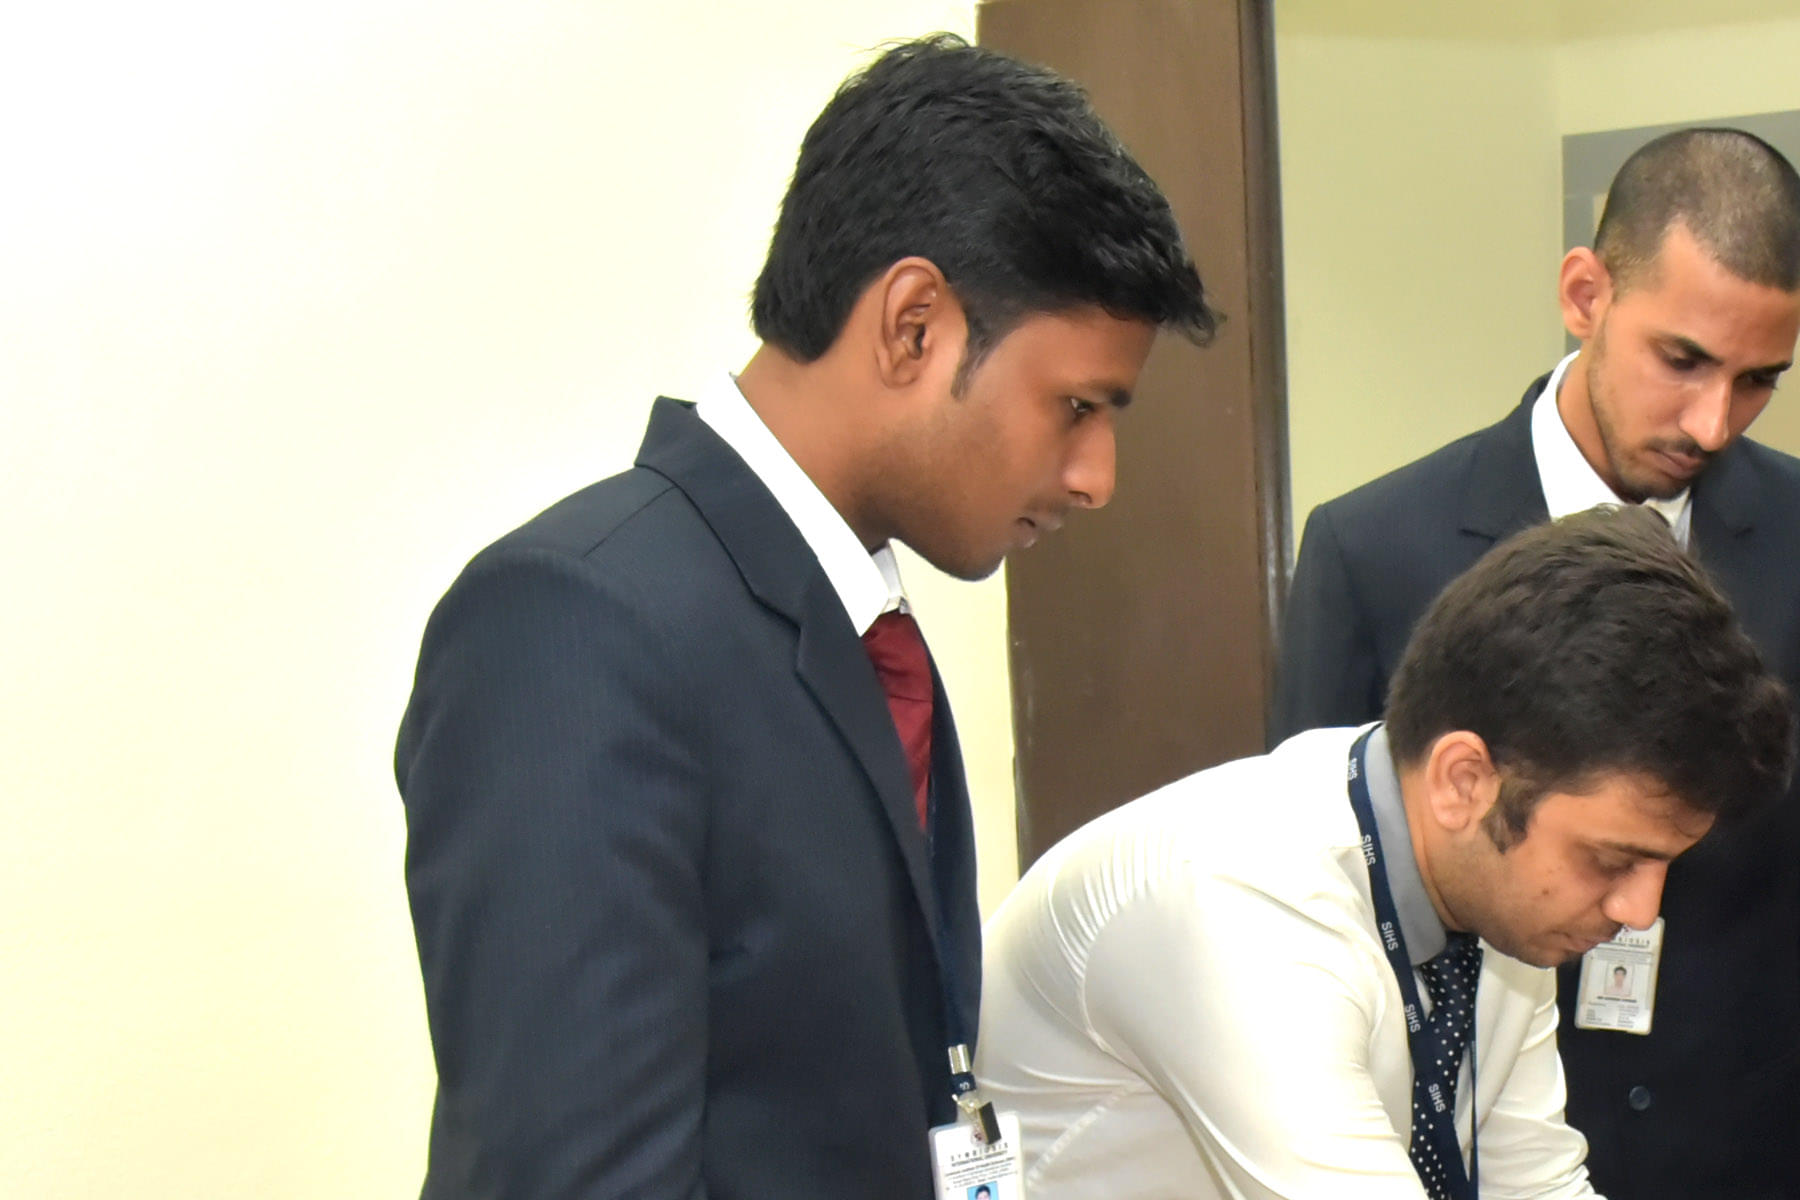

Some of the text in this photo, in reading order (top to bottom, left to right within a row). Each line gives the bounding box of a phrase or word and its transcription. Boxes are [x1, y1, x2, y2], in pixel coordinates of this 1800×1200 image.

[1362, 834, 1377, 866] SIHS
[1381, 921, 1399, 951] SIHS
[1406, 1003, 1421, 1033] SIHS
[1428, 1083, 1446, 1113] SIHS
